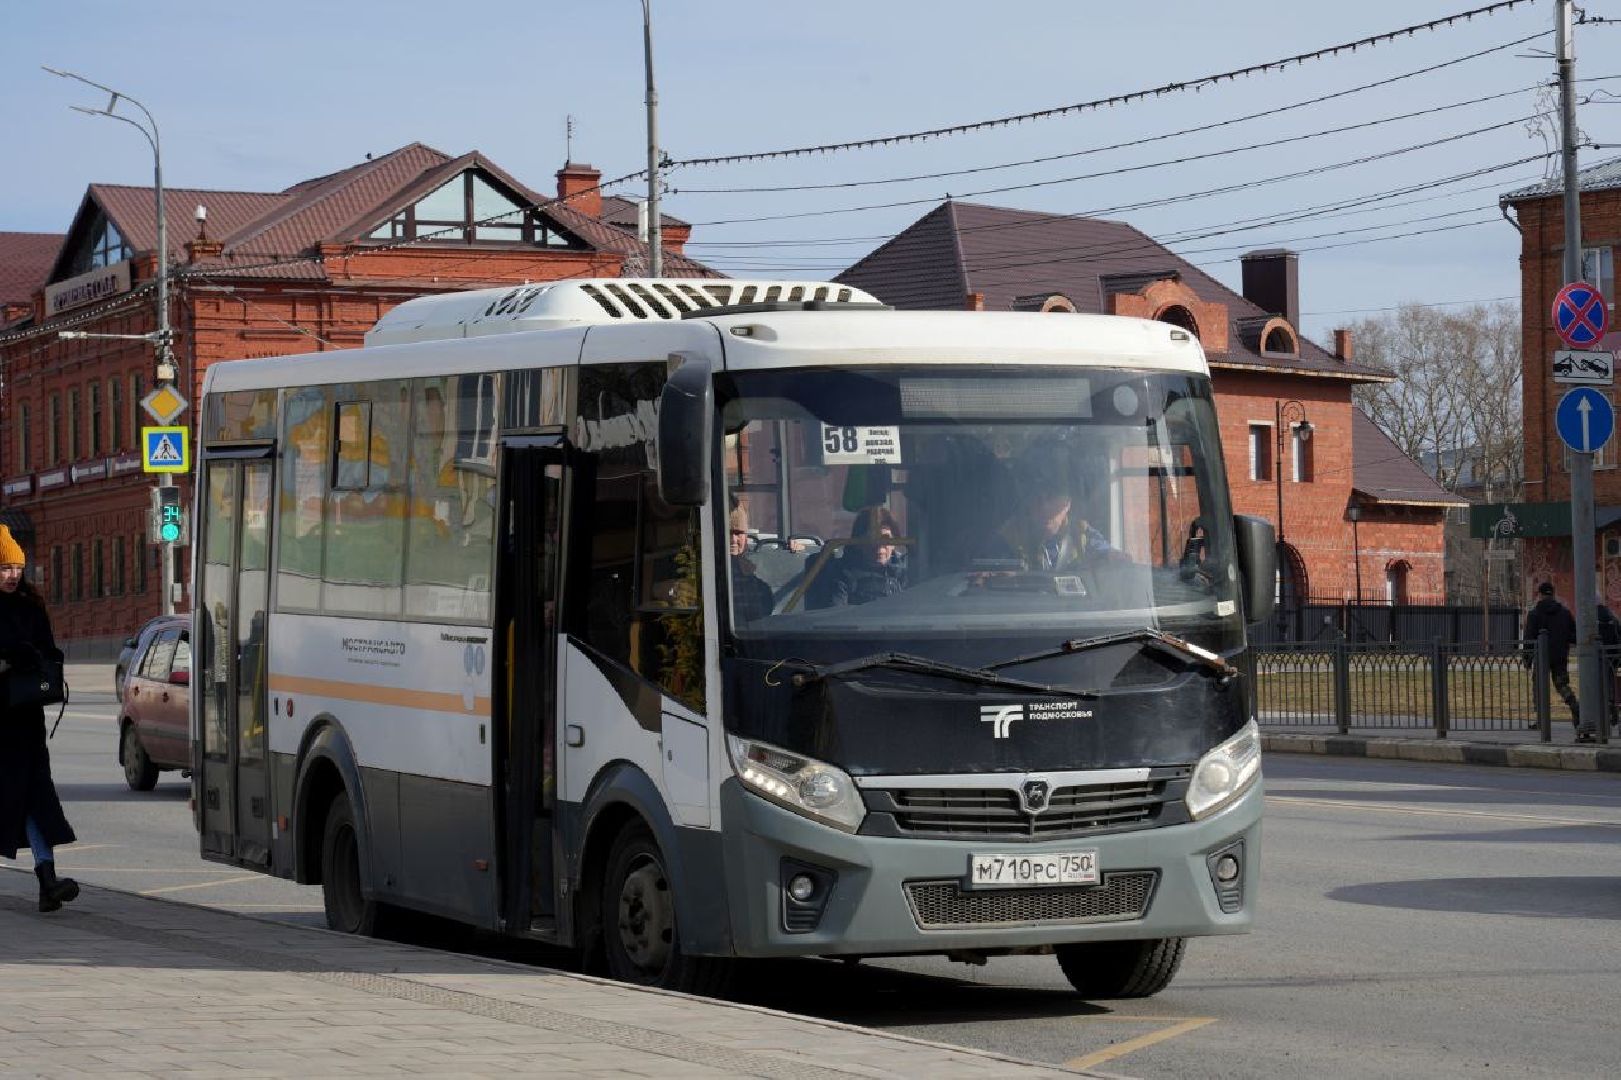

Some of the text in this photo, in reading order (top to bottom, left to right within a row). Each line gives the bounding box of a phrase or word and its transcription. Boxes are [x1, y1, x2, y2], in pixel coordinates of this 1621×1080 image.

[824, 426, 858, 454] 58
[163, 506, 179, 522] 34
[1029, 702, 1078, 711] ТРАНСПОРТ
[1029, 711, 1093, 720] ПОДМОСКОВЬЯ
